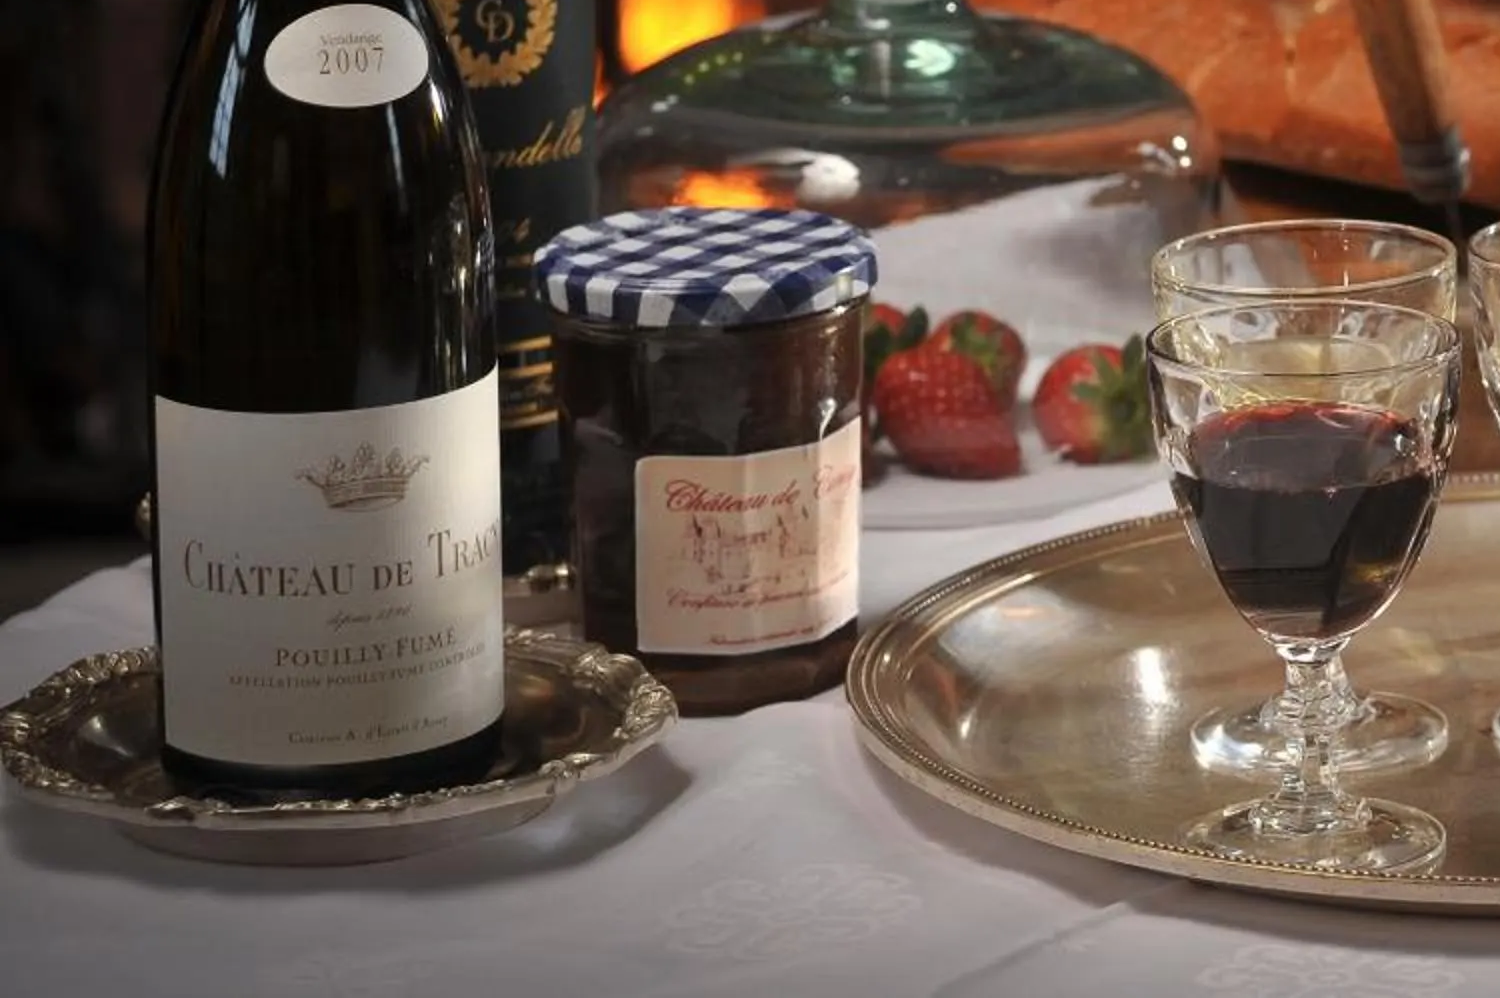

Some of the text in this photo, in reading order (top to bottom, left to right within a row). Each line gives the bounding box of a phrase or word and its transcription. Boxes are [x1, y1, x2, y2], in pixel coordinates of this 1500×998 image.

[318, 47, 384, 75] 2007
[372, 560, 413, 591] DE
[275, 645, 387, 667] POUILLY
